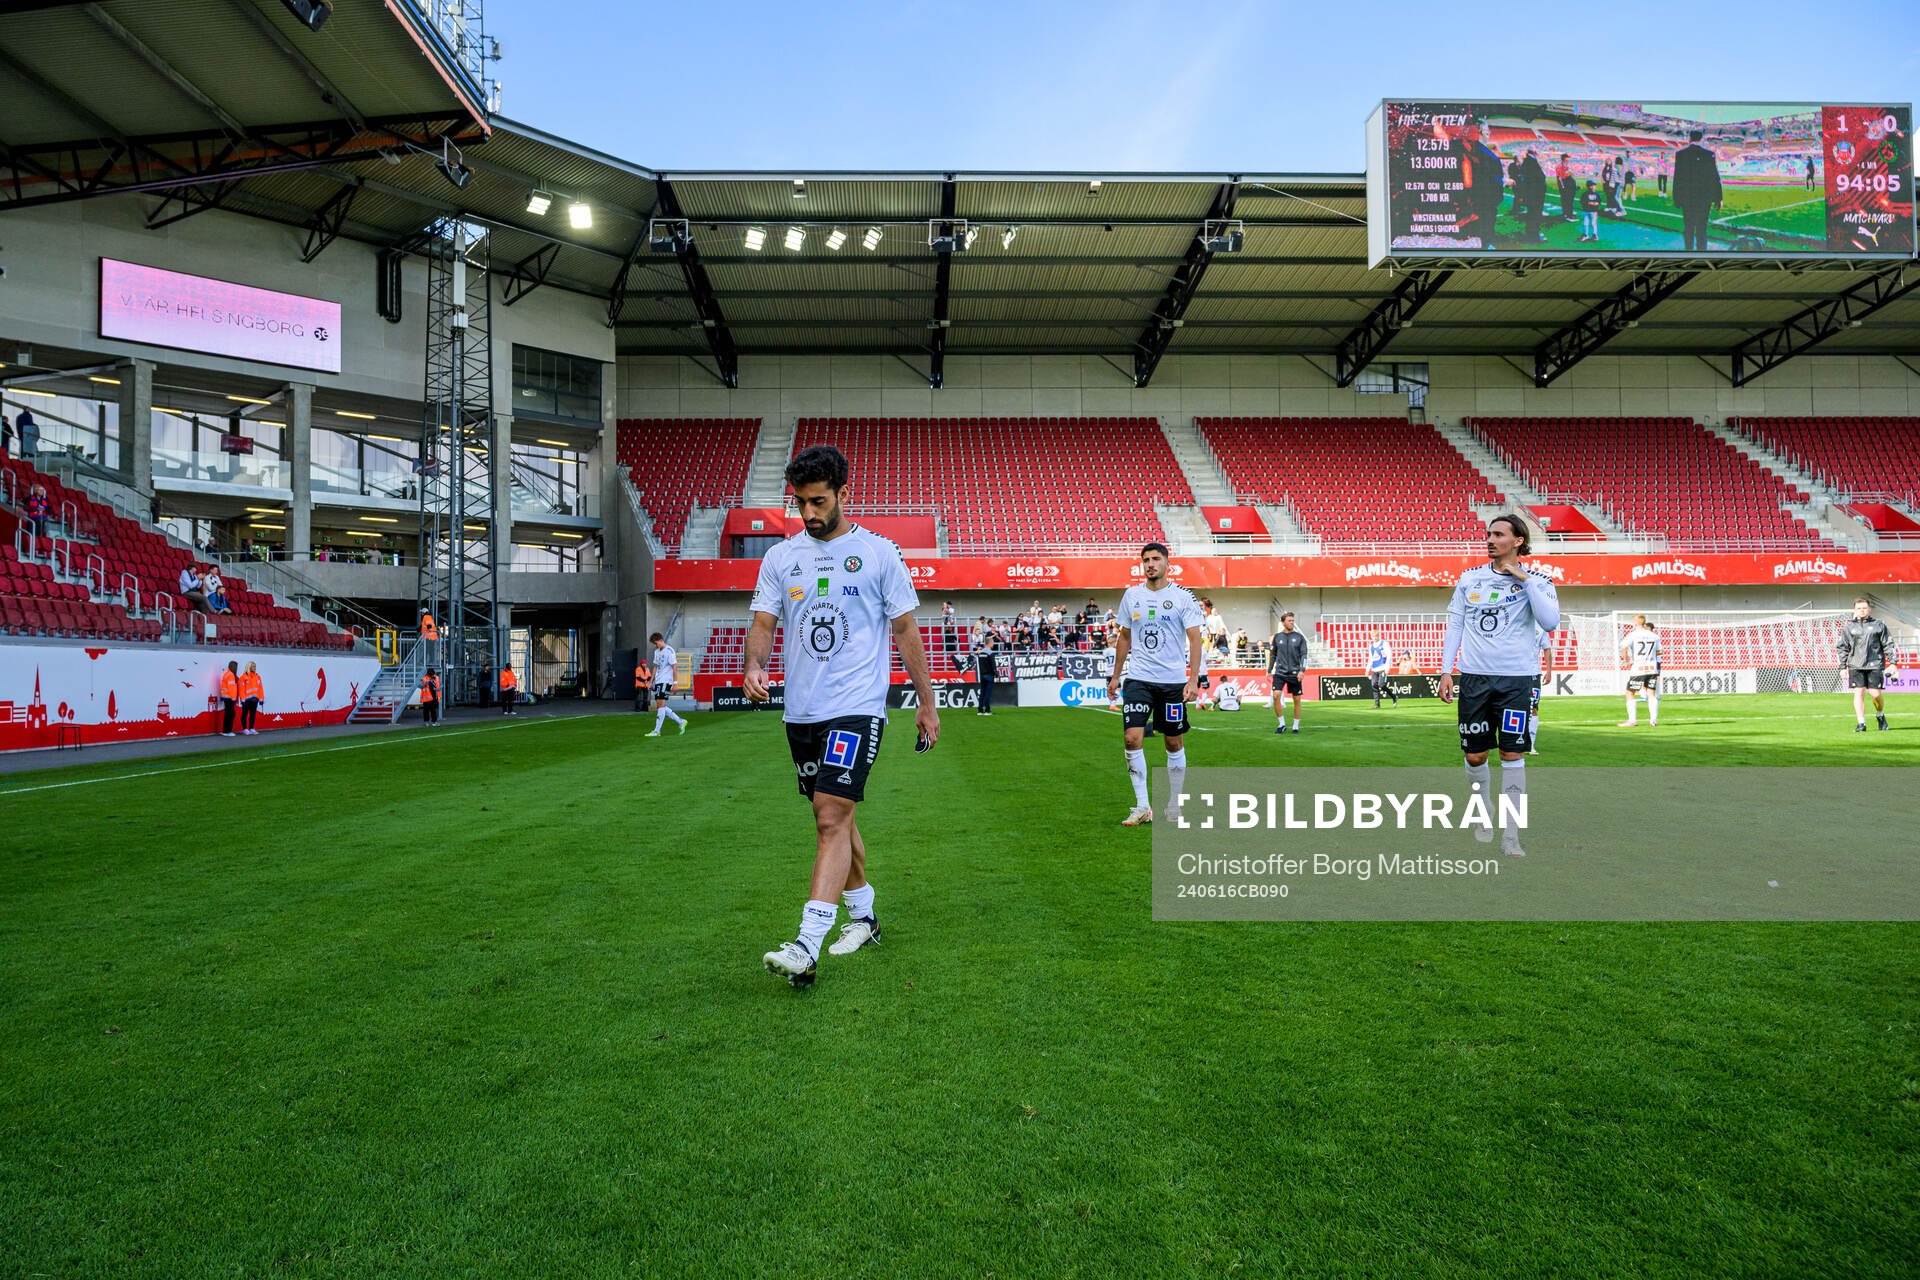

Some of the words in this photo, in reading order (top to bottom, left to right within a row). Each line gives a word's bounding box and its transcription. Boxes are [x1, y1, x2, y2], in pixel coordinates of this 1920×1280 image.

[1837, 115, 1849, 132] 1
[1883, 115, 1898, 132] 0
[1410, 157, 1443, 169] 13.600
[1444, 157, 1457, 169] KR
[1836, 174, 1901, 192] 94:05
[1007, 563, 1044, 577] akea
[1346, 560, 1421, 581] RAMLÖSA
[1631, 559, 1706, 580] RAMLÖSA
[1773, 558, 1848, 579] RAMLÖSA
[842, 586, 860, 596] NA
[1505, 595, 1517, 603] NA
[1637, 641, 1655, 656] 27
[1014, 655, 1058, 666] ULTRAS
[1016, 666, 1057, 677] NIKOLAI
[1330, 681, 1361, 696] Valvet
[1662, 672, 1737, 693] mobil
[1224, 687, 1236, 697] 12
[718, 697, 740, 705] GOTT
